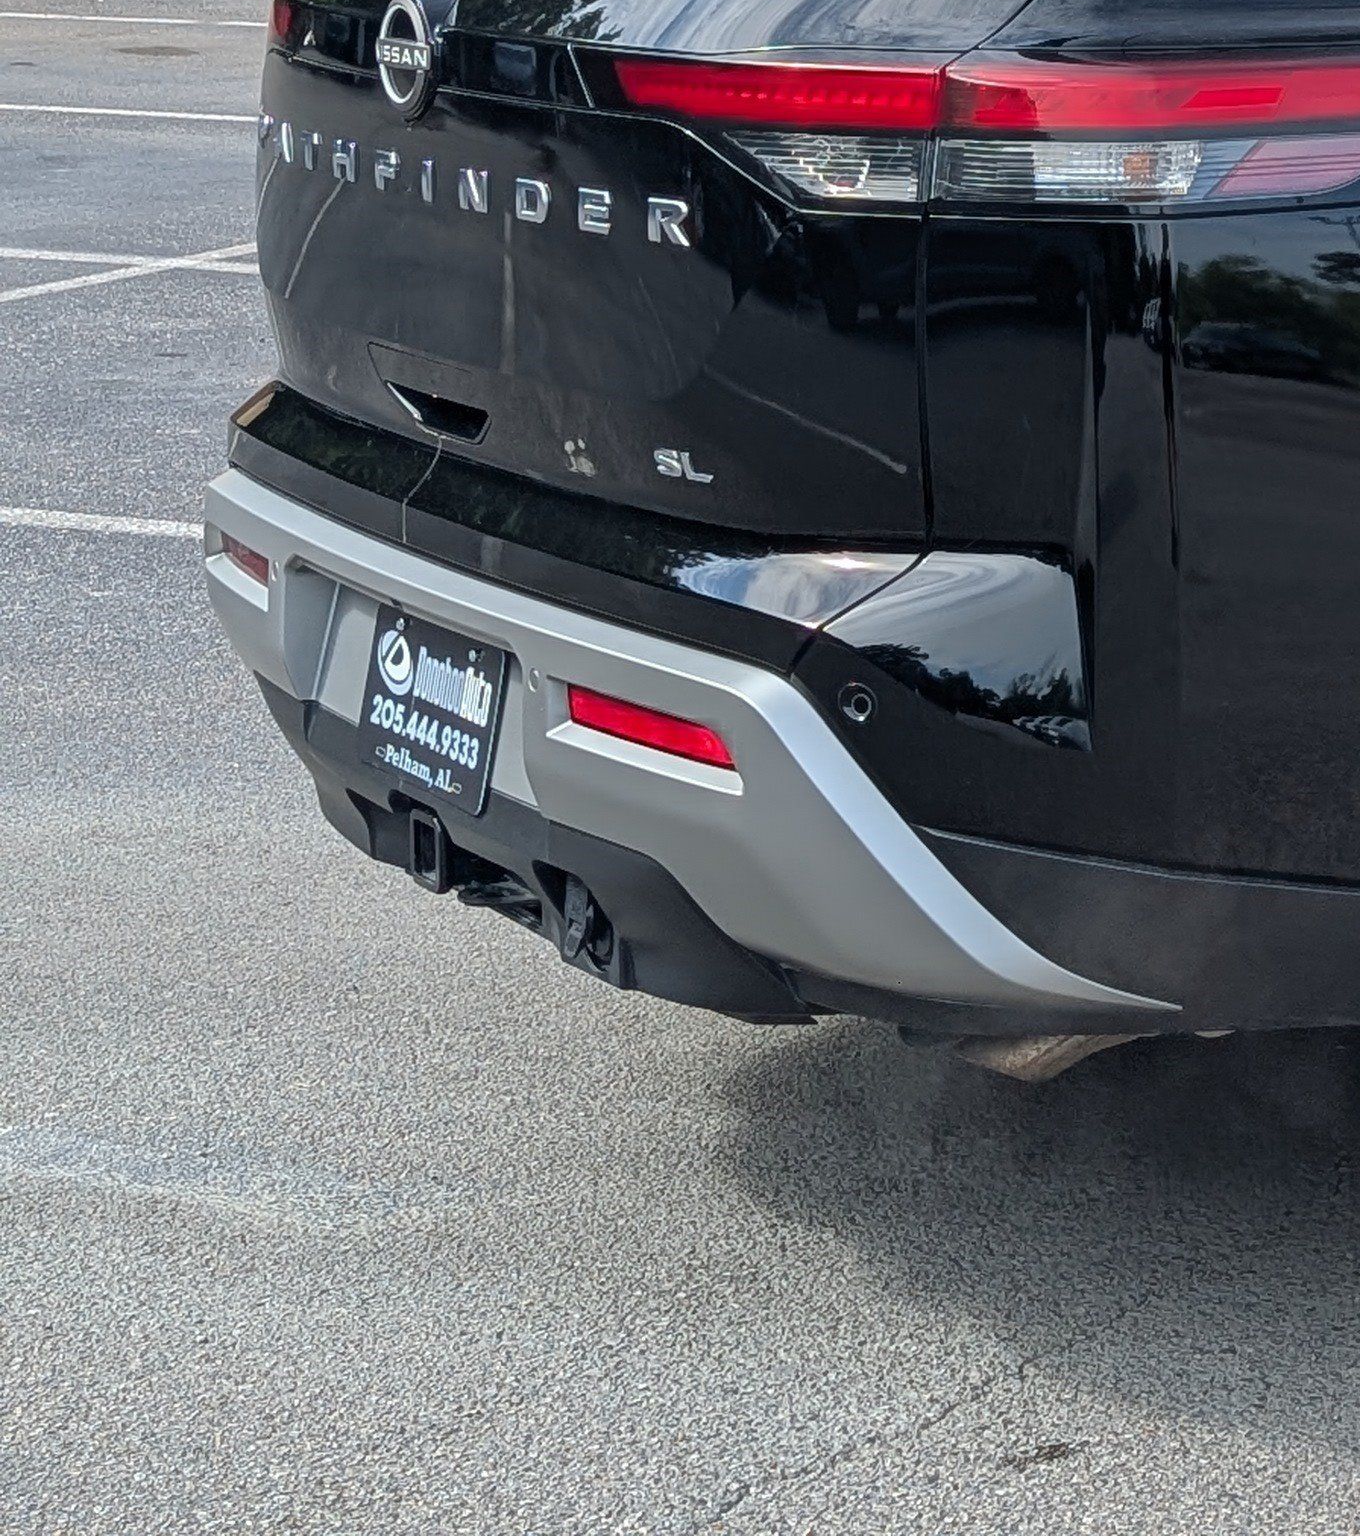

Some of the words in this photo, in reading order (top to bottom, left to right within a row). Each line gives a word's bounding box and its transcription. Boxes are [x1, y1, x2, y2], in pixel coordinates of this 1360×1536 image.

[378, 44, 428, 68] ISSAN
[653, 448, 714, 483] SL
[369, 693, 480, 770] 205.444.9333
[384, 743, 433, 788] Pelham,
